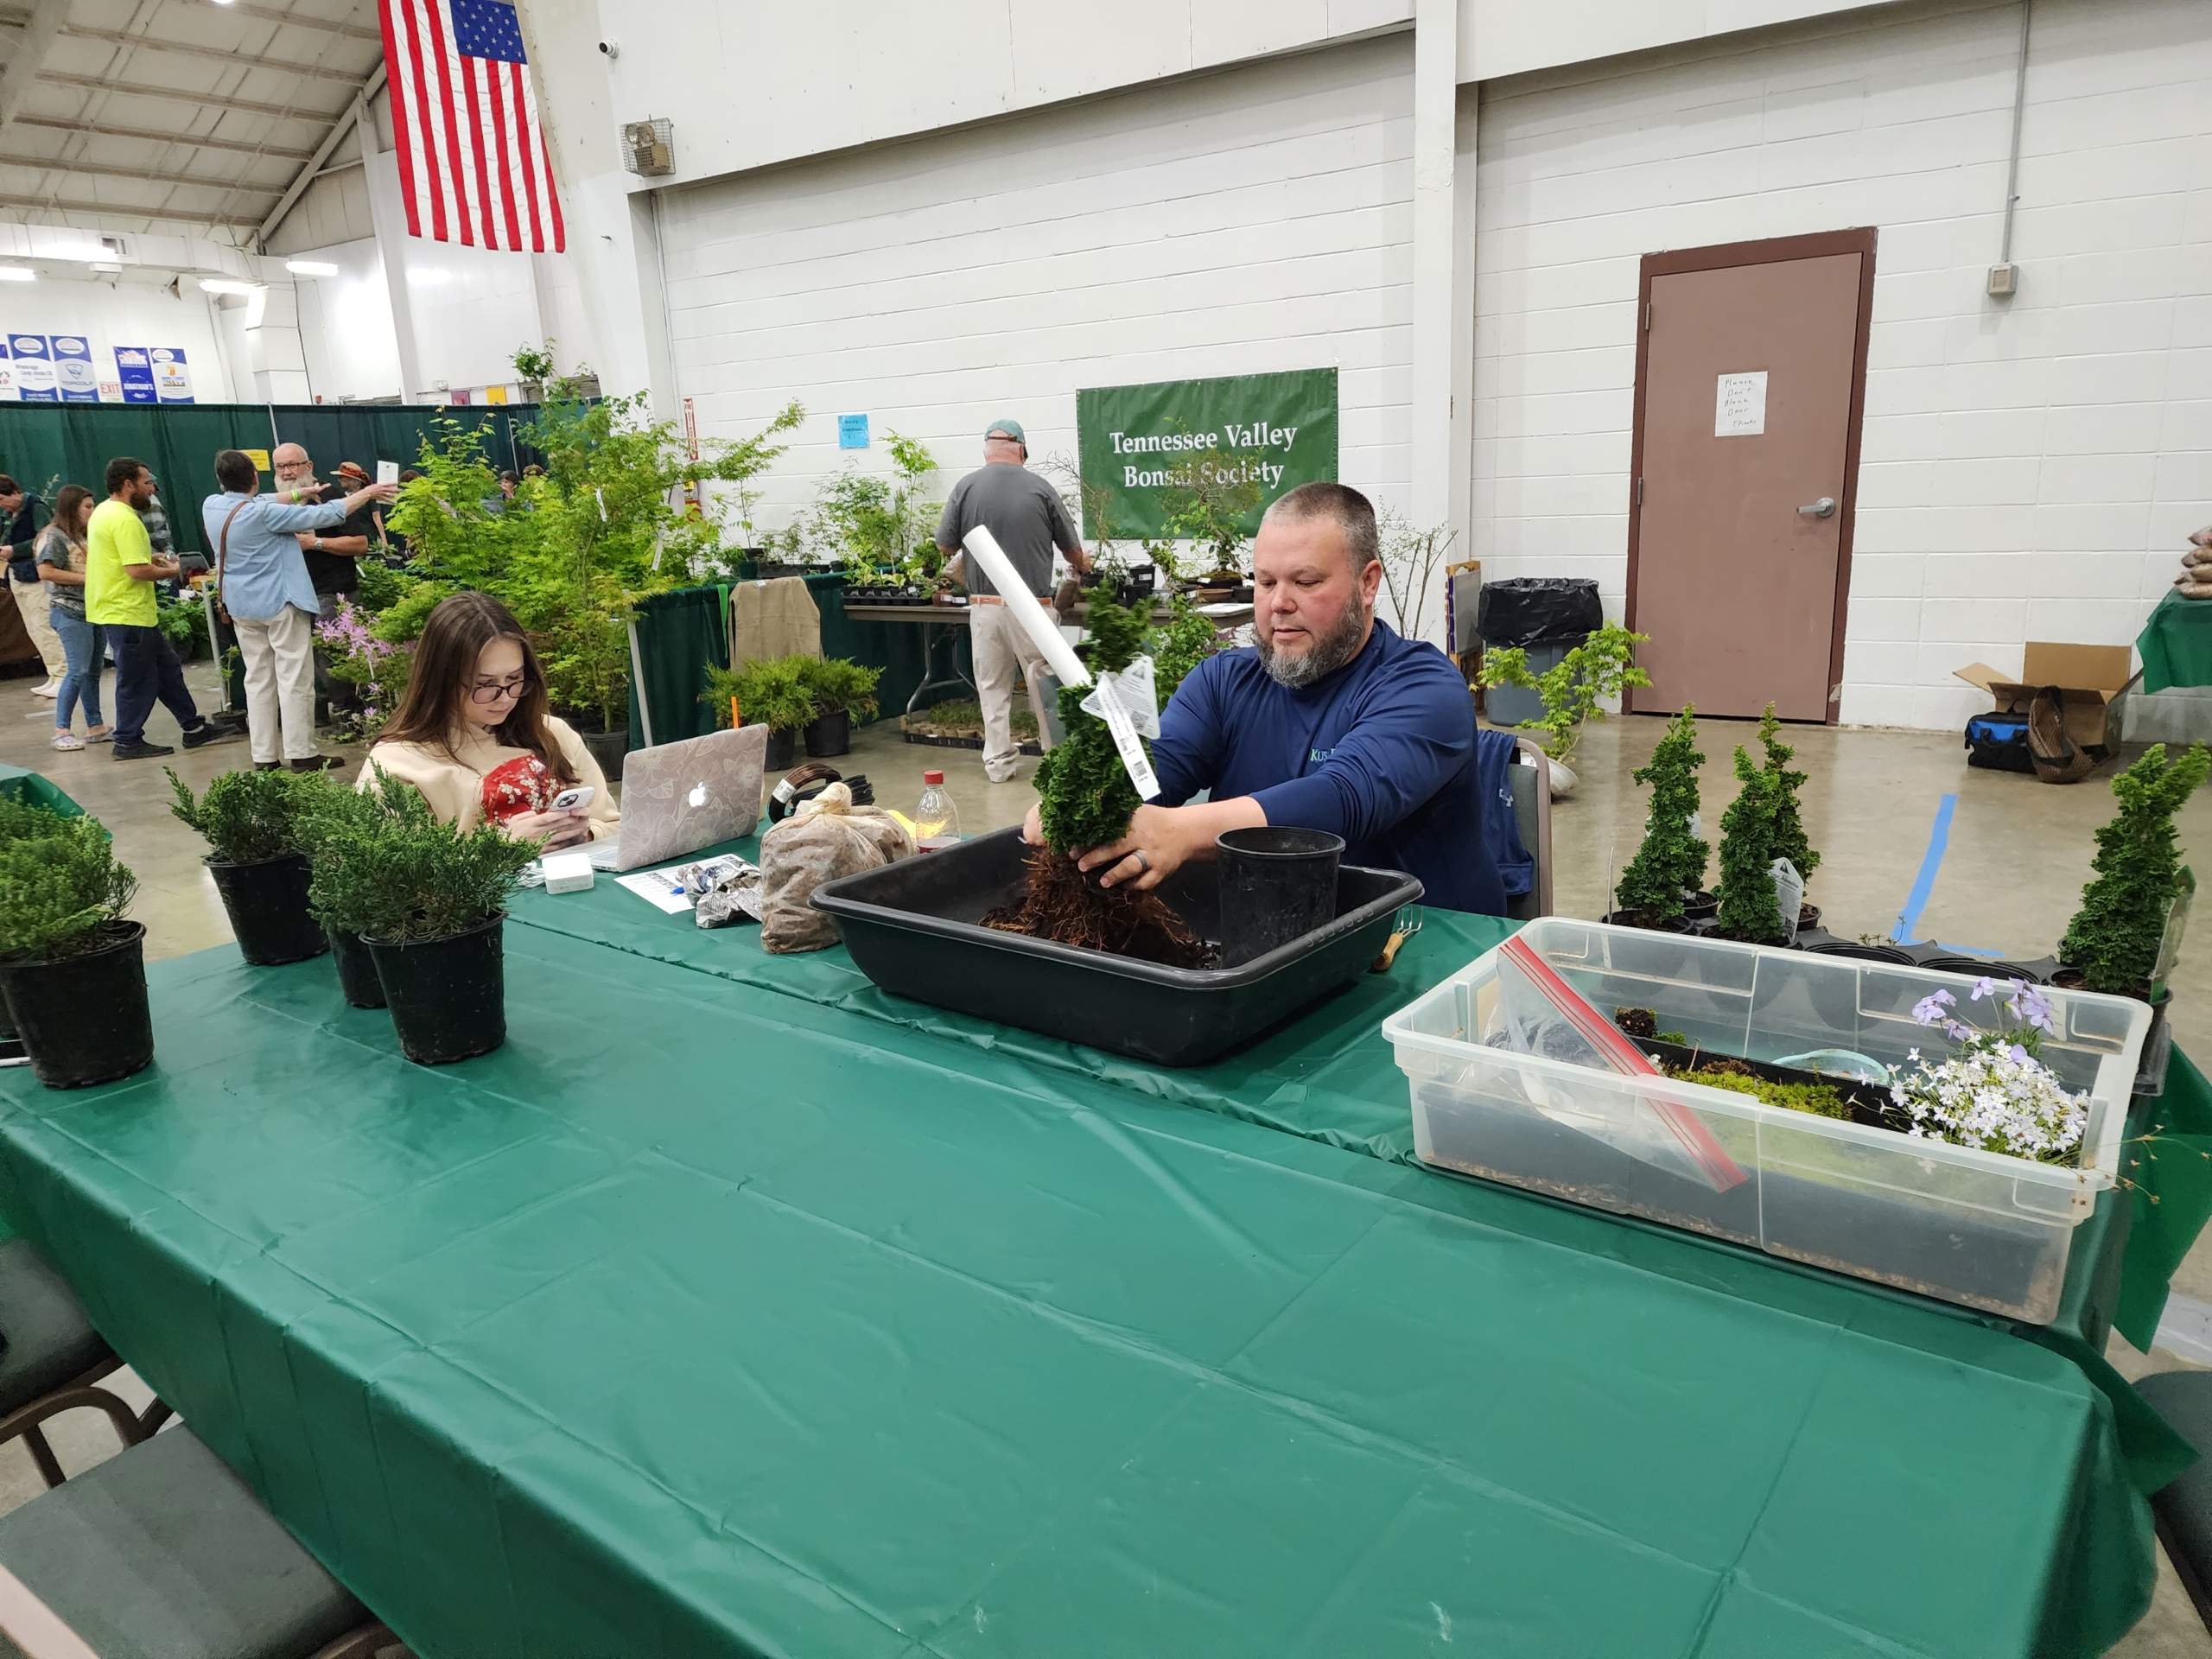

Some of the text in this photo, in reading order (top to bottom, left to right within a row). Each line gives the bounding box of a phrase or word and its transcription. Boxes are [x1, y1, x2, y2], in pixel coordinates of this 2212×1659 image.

[100, 383, 120, 394] EXIT
[1725, 378, 1755, 388] Please
[1727, 408, 1749, 416] Door
[1109, 421, 1298, 454] Tennessee Valley
[1123, 460, 1284, 489] Bonsai Society
